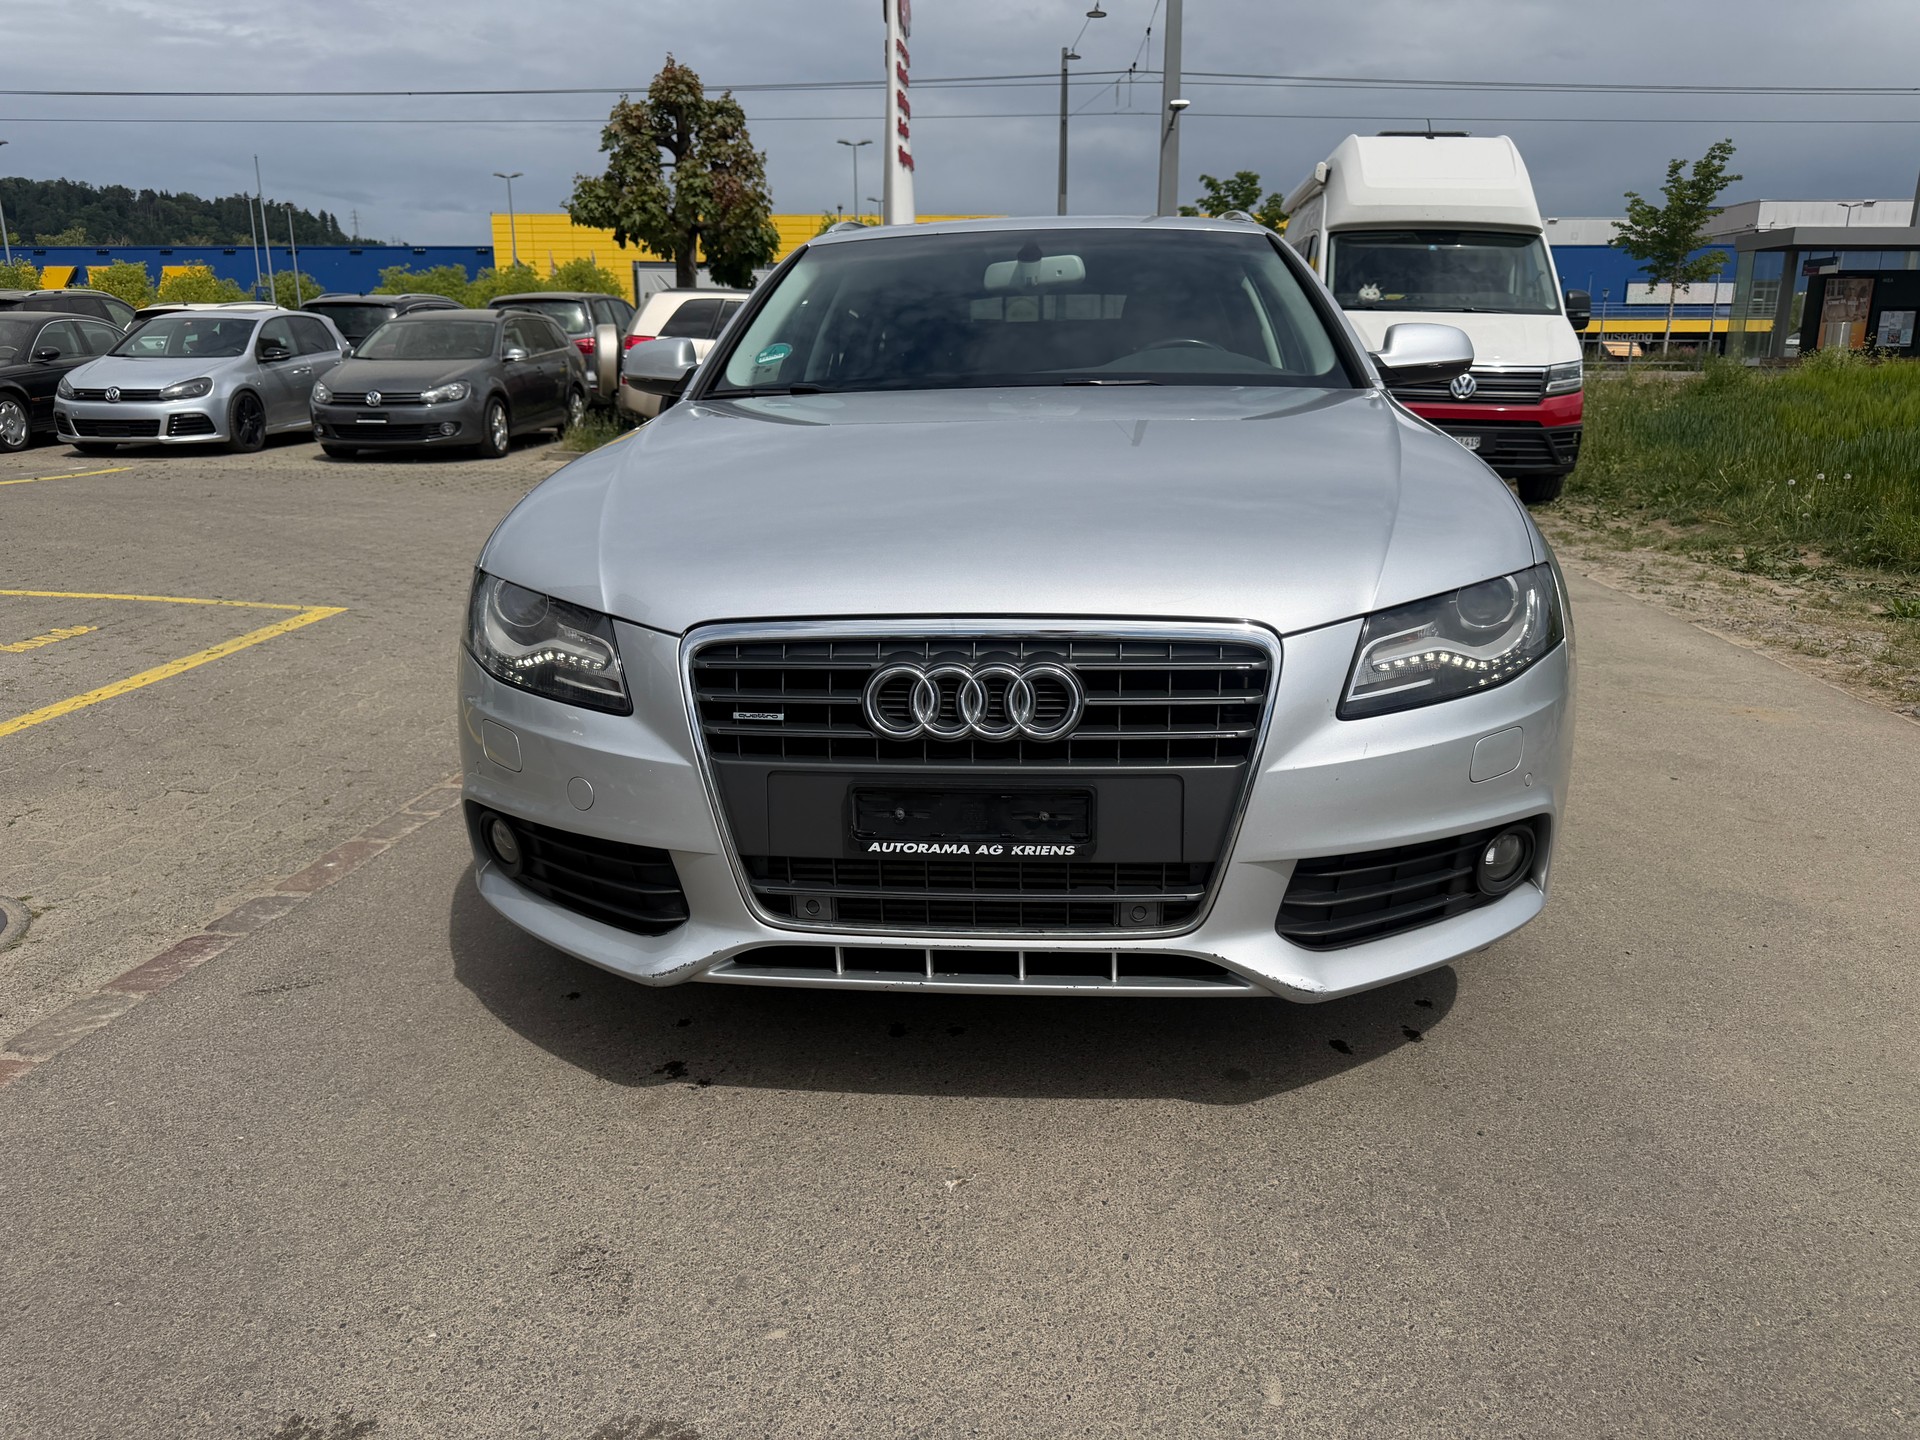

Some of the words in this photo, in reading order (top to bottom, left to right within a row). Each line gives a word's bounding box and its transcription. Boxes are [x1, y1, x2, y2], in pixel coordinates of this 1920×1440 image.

[867, 842, 971, 855] AUTORAMA
[974, 843, 1004, 856] AG
[1010, 844, 1076, 856] KRIENS
